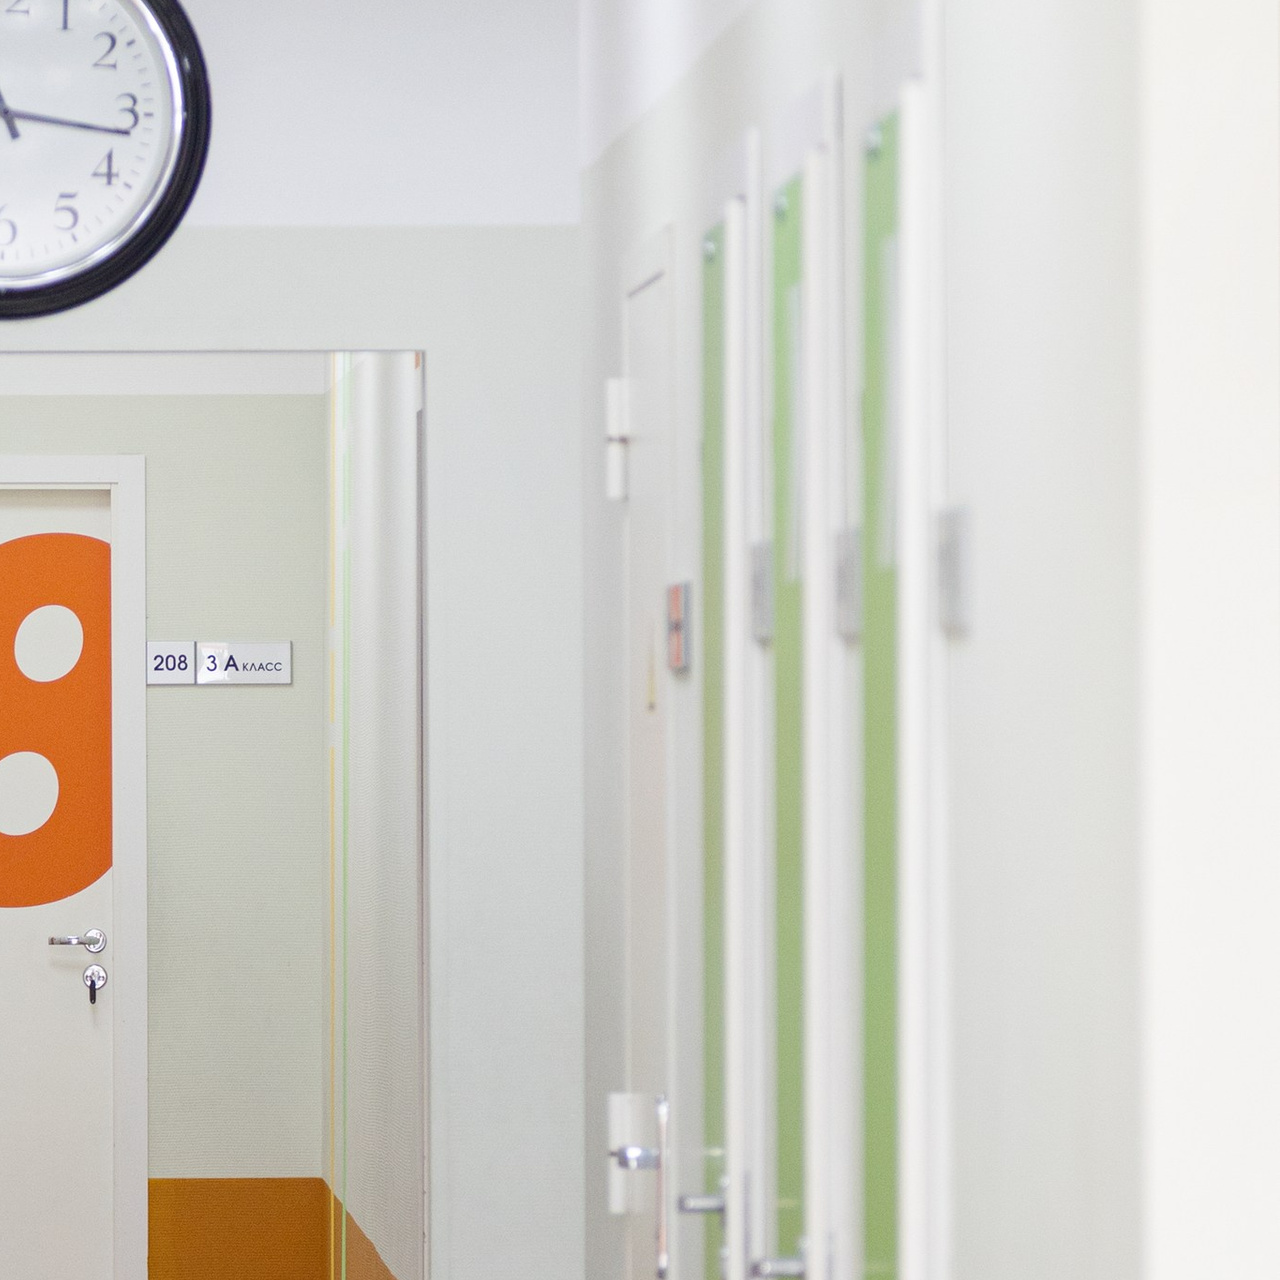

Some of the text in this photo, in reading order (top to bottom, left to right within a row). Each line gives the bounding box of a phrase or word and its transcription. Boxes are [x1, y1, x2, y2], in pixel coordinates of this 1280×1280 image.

[92, 32, 118, 69] 2
[117, 93, 140, 133] 3
[91, 148, 119, 186] 4
[54, 192, 79, 230] 5
[153, 654, 188, 671] 208
[206, 655, 282, 671] 3 А КЛАСС
